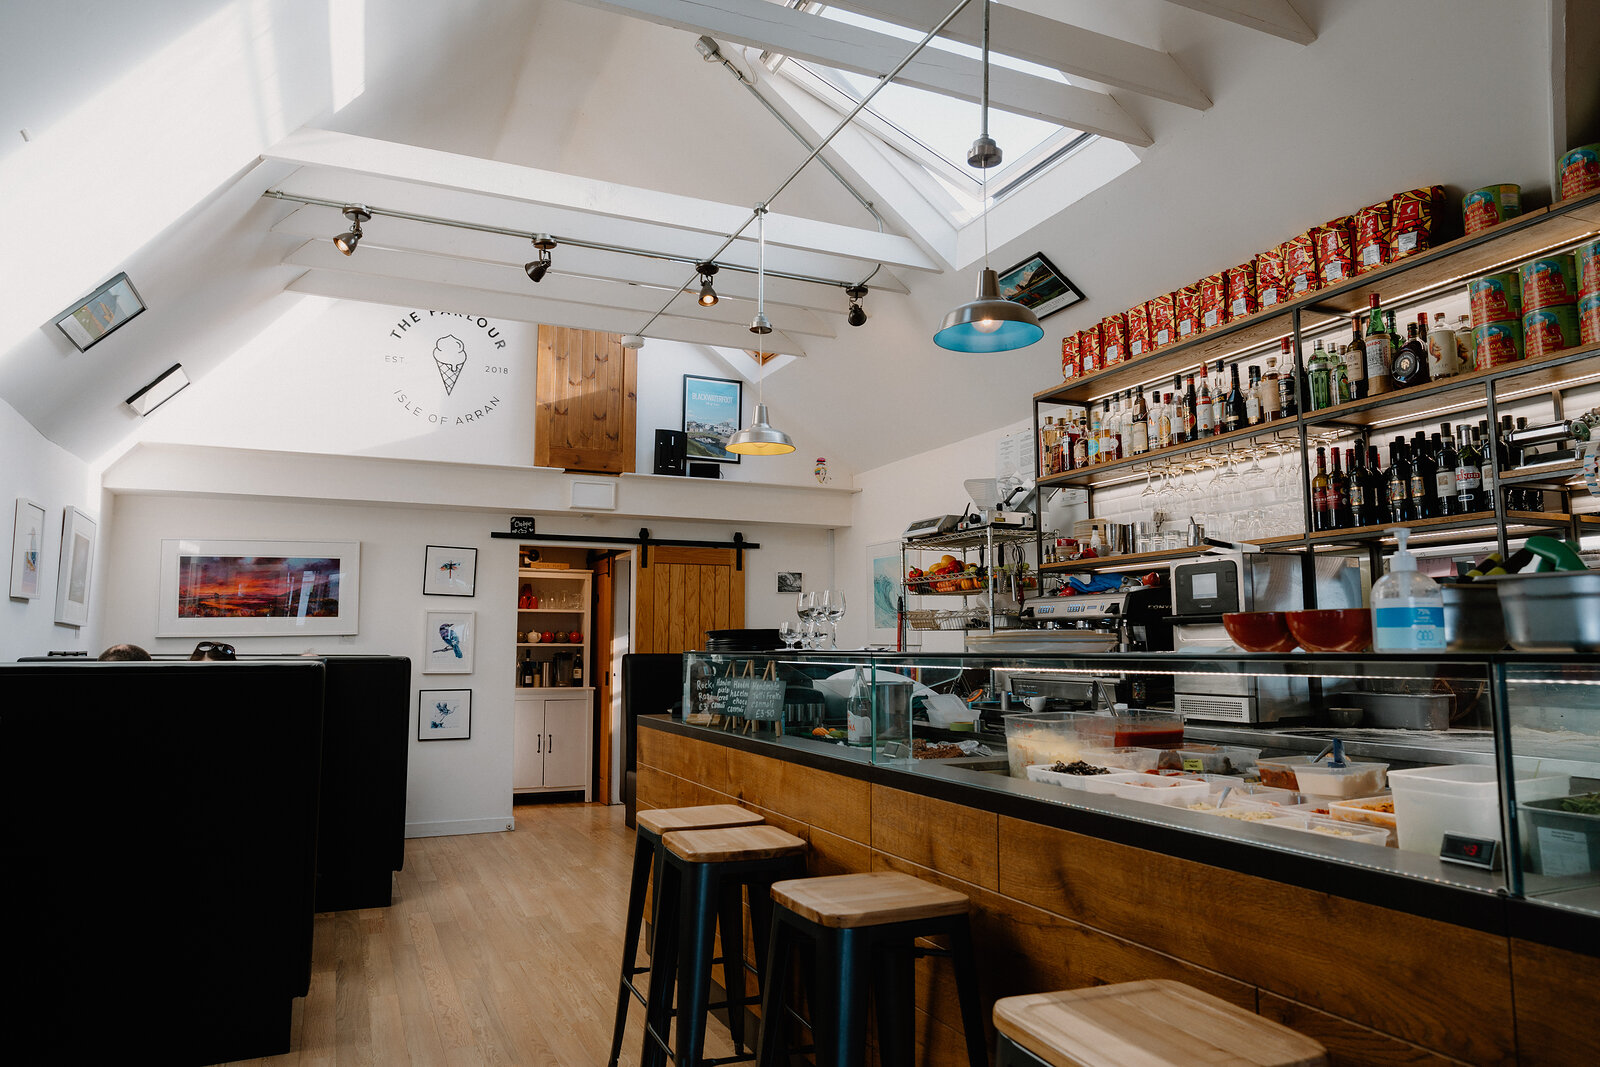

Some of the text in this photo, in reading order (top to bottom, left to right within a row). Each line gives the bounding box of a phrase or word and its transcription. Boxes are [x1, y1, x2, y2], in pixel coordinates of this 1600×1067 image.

[390, 311, 421, 340] THE
[485, 366, 509, 375] 2018
[394, 389, 500, 426] ISLE OF ARRAN
